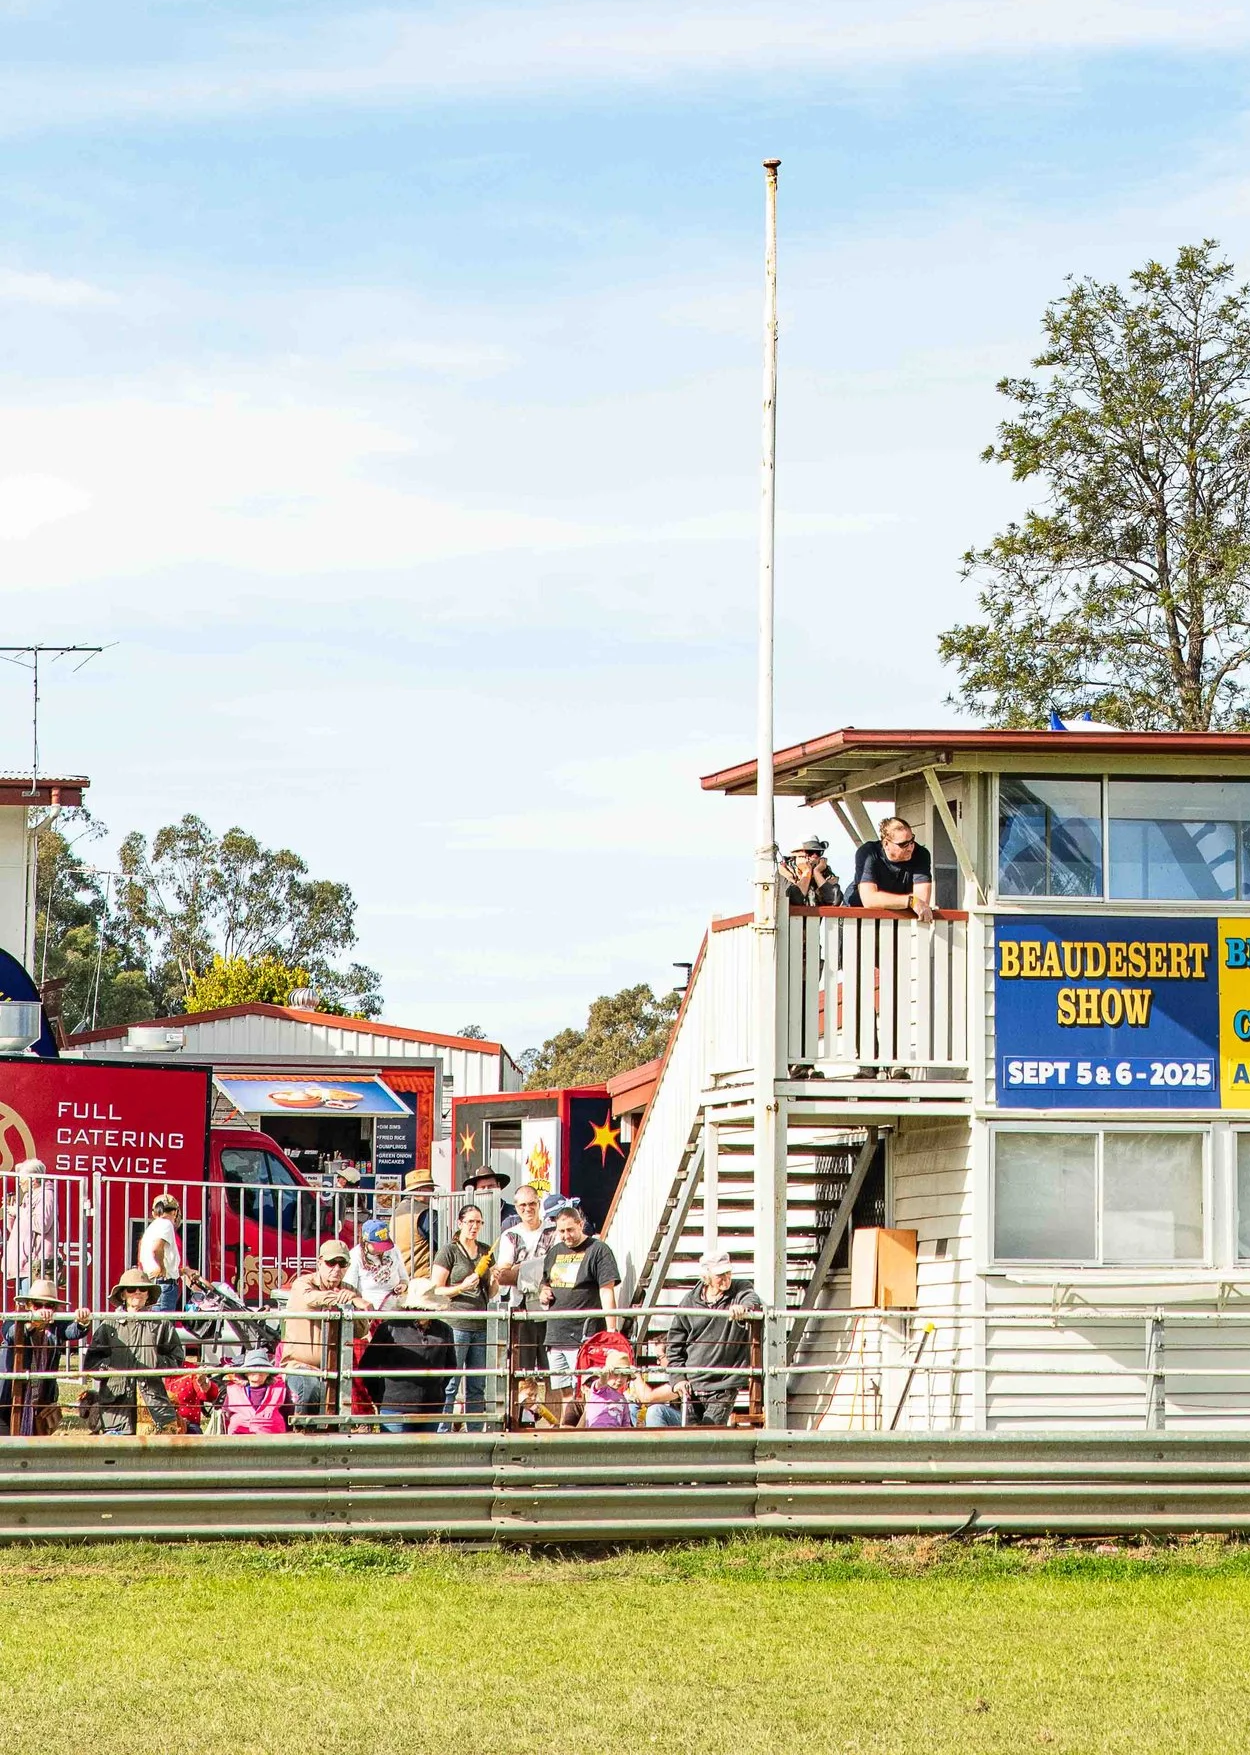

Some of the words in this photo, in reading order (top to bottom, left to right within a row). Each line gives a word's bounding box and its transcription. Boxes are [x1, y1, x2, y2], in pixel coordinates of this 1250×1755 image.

[998, 940, 1209, 980] BEAUDESERT
[1056, 987, 1152, 1027] SHOW
[1008, 1062, 1070, 1085] SEPT
[1076, 1062, 1093, 1085] 5
[1095, 1065, 1111, 1085] &
[1115, 1063, 1133, 1086] 6
[1149, 1062, 1212, 1086] 2025
[58, 1101, 122, 1120] FULL
[57, 1128, 184, 1149] CATERING
[56, 1154, 167, 1174] SERVICE
